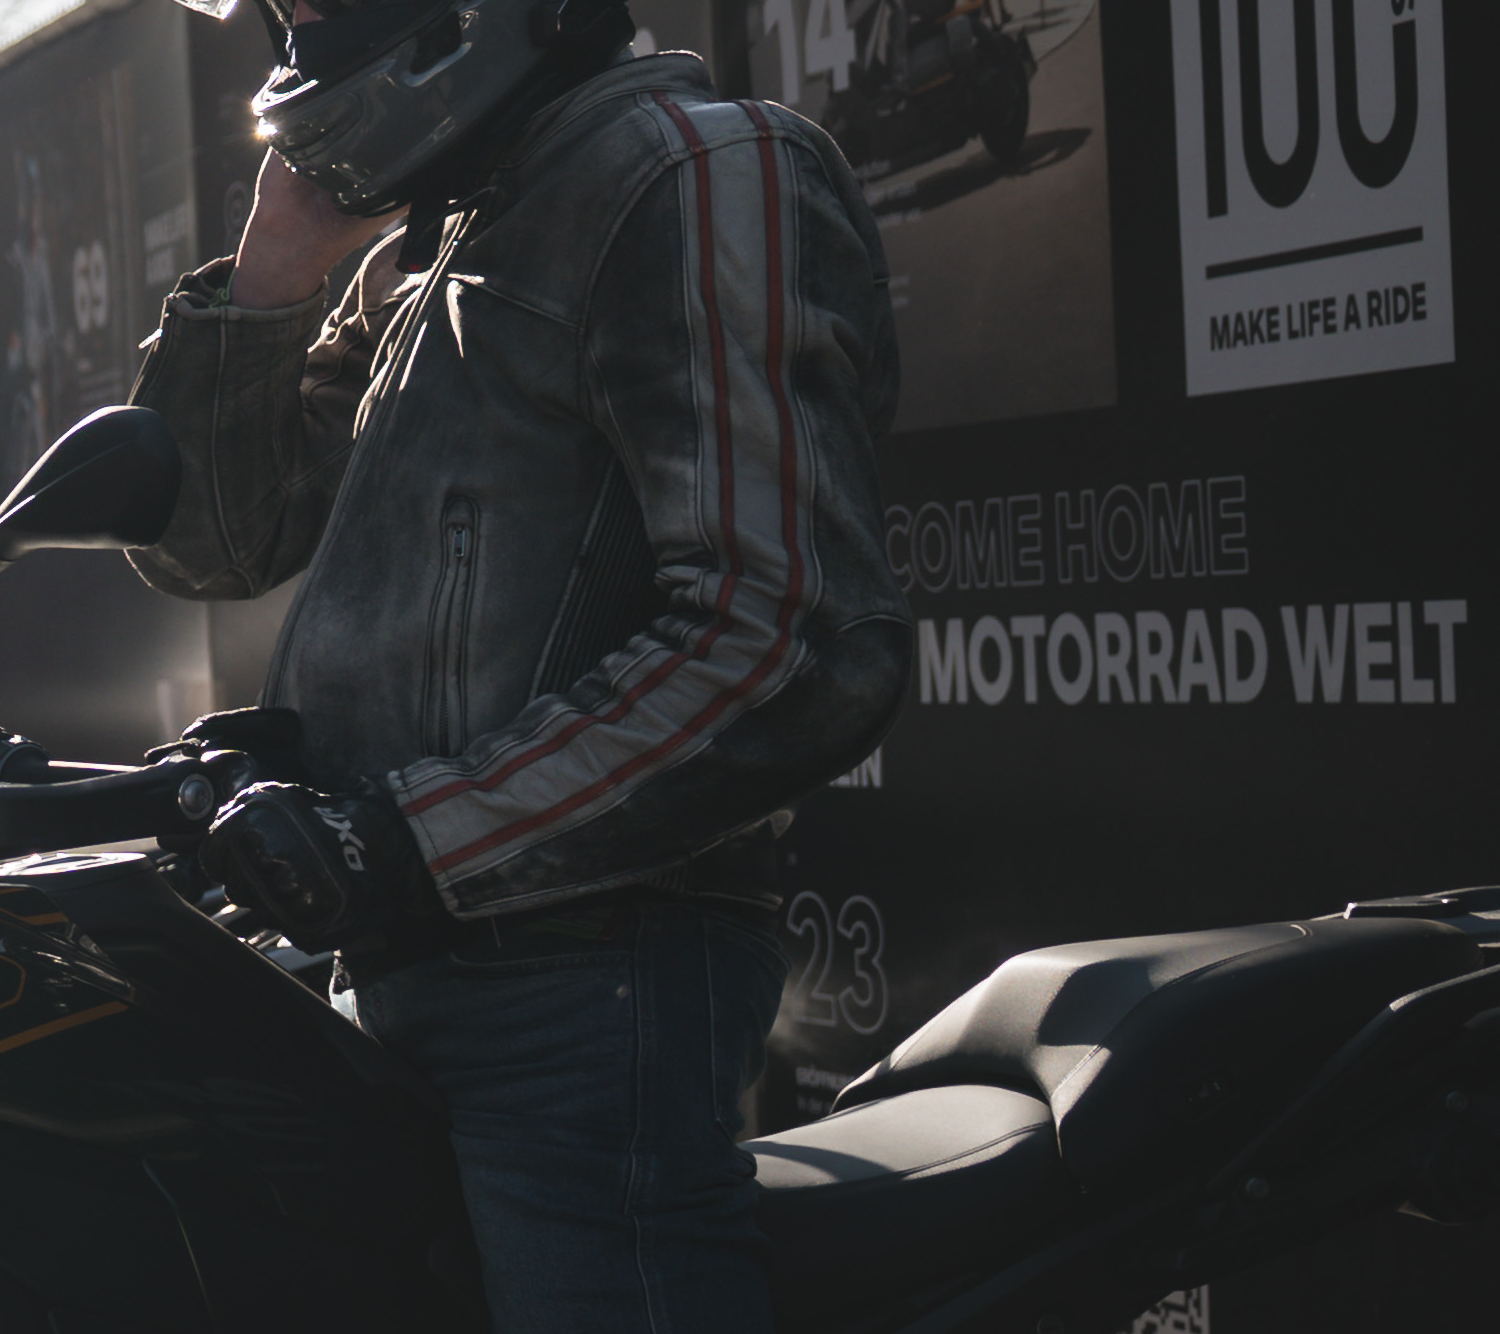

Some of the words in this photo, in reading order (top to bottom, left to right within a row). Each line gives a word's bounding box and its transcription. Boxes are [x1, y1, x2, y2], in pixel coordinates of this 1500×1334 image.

[1210, 305, 1280, 352] MAKE
[1287, 297, 1337, 340] LIFE
[1344, 294, 1362, 332] A
[1367, 282, 1427, 328] RIDE
[1054, 475, 1250, 583] HOME
[919, 606, 1268, 706] MOTORRAD
[1281, 599, 1467, 704] WELT
[786, 890, 889, 1035] 23
